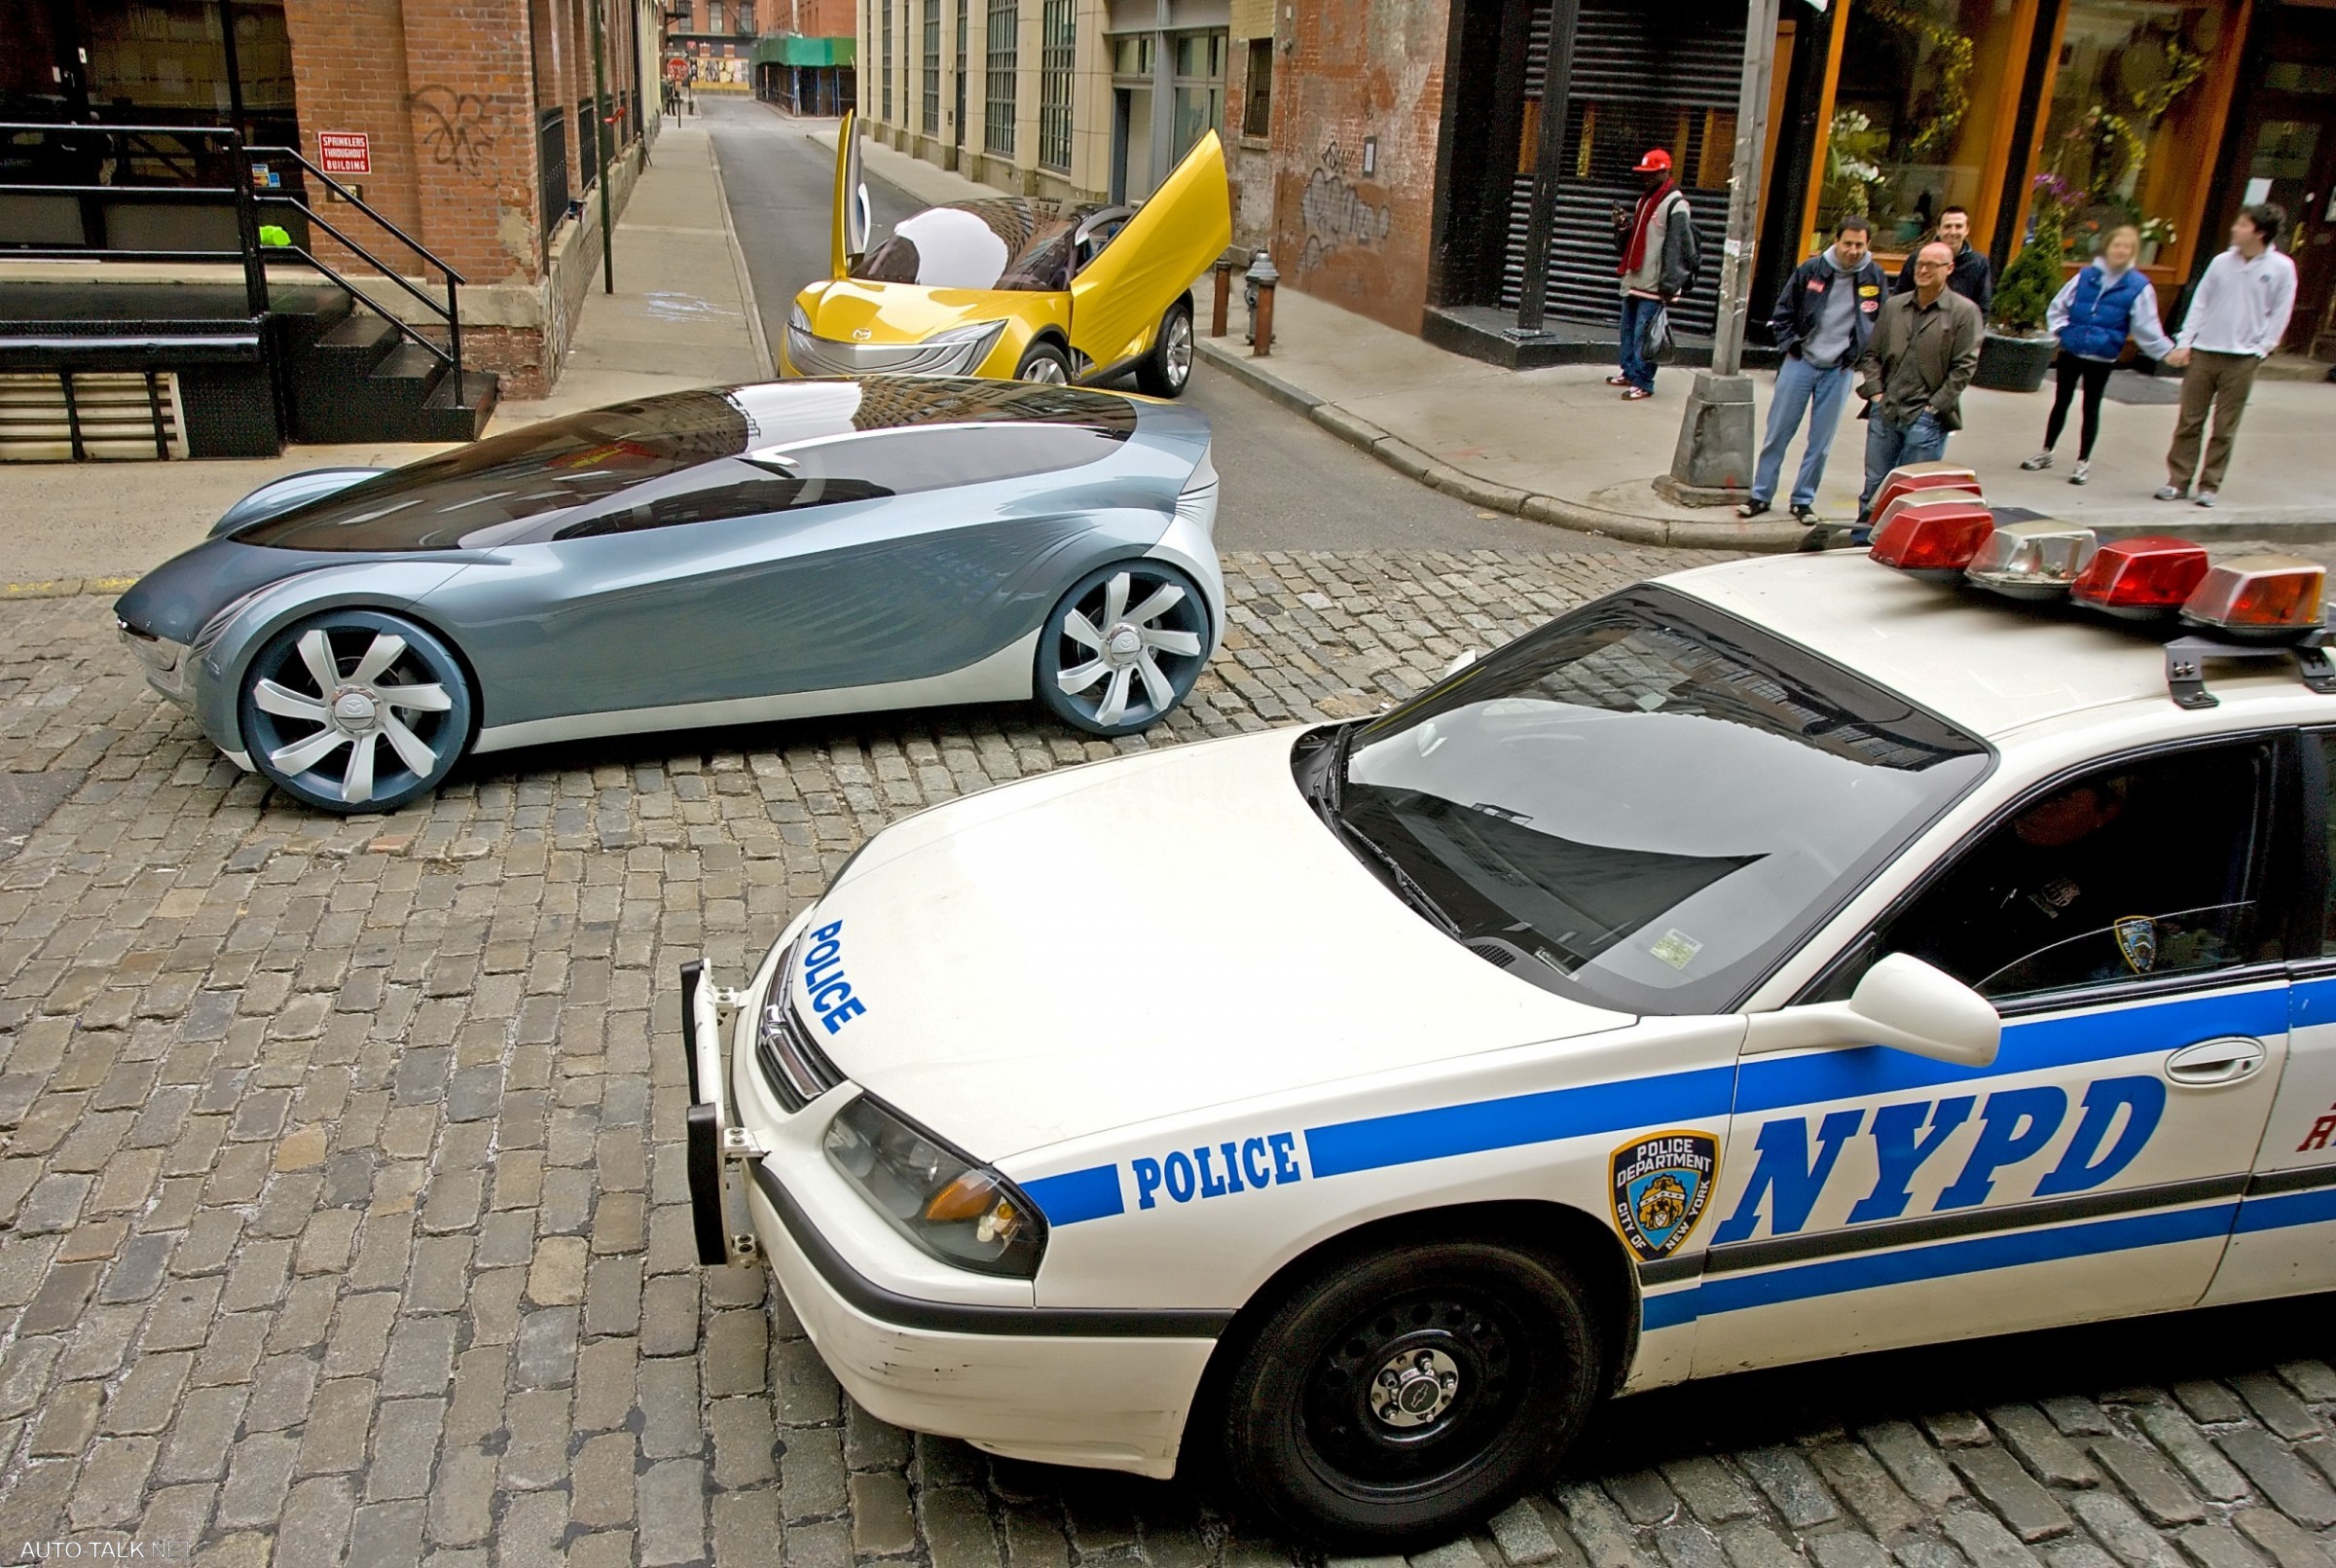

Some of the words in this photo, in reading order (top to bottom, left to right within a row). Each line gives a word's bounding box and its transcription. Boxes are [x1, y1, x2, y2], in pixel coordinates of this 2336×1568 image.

[323, 136, 365, 147] SPRINKLERS
[324, 148, 366, 158] THROUGHOUT
[326, 161, 366, 170] BUILDING
[804, 919, 867, 1036] POLICE
[1617, 1152, 1712, 1188] DEPARTMENT
[1637, 1138, 1694, 1161] POLICE
[1709, 1075, 2167, 1245] NYPD
[1132, 1131, 1301, 1211] POLICE
[1617, 1202, 1635, 1232] CITY
[1630, 1234, 1647, 1250] OF
[1664, 1222, 1690, 1250] NEW
[1688, 1179, 1711, 1217] YORK
